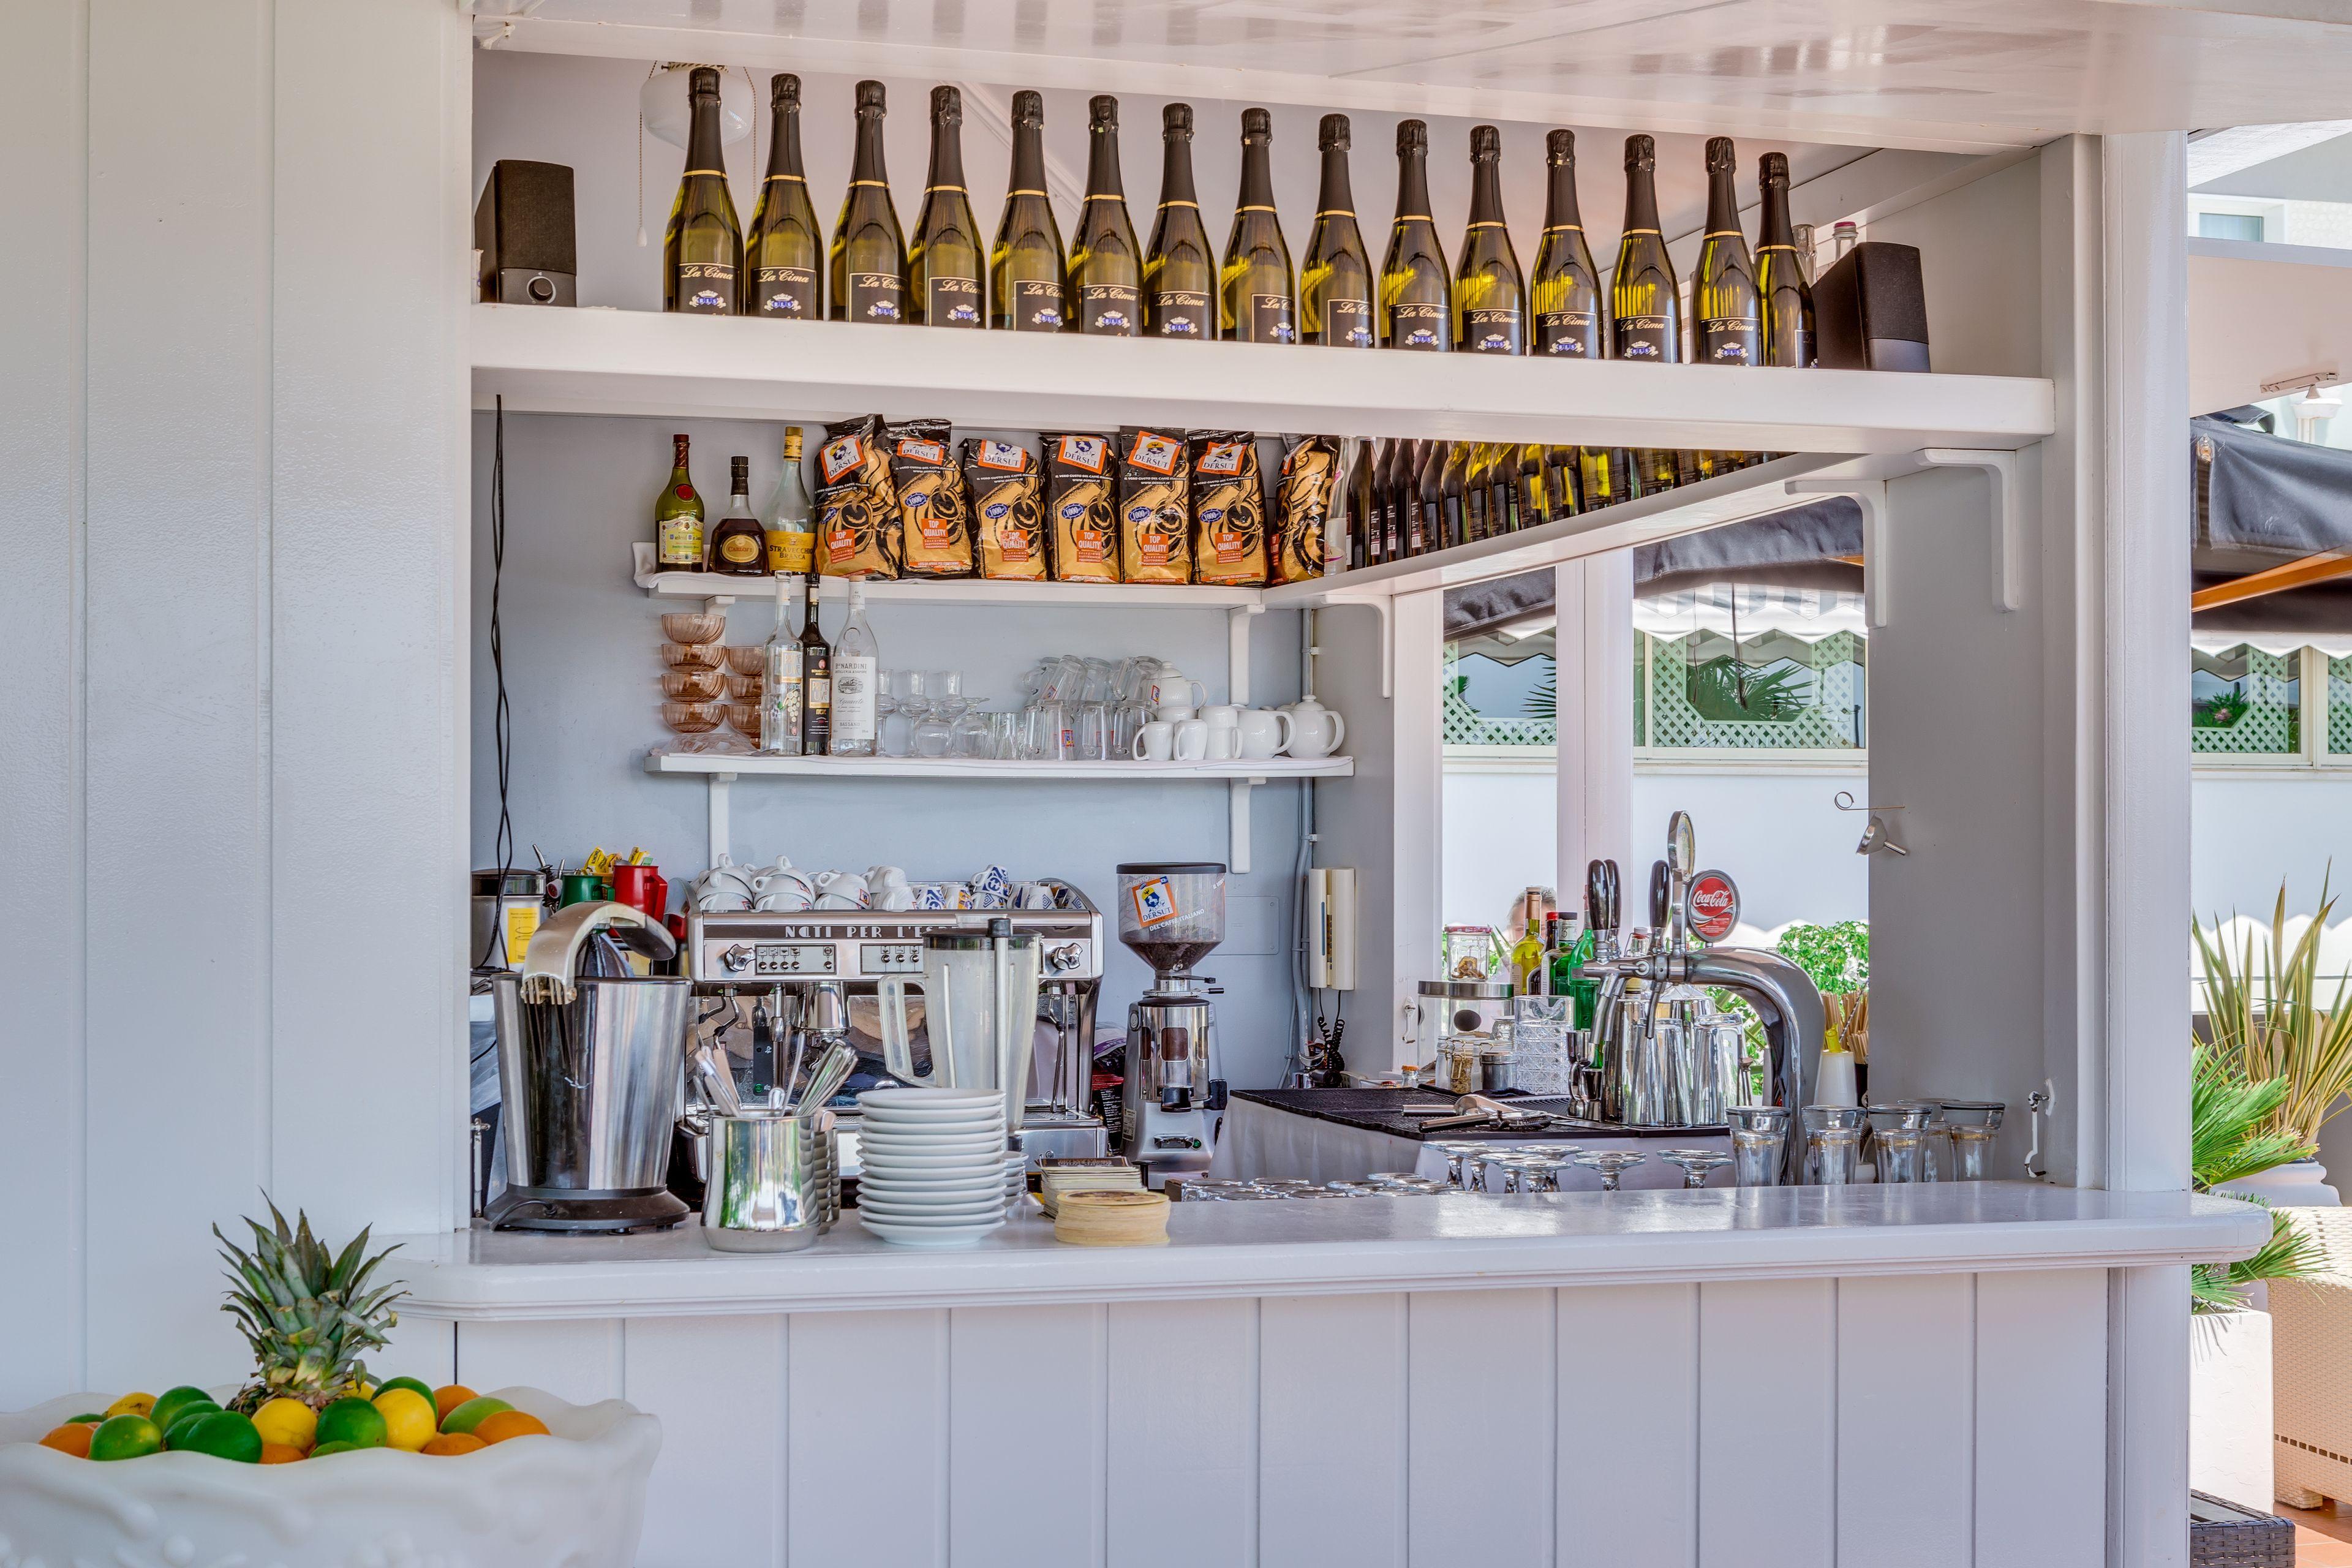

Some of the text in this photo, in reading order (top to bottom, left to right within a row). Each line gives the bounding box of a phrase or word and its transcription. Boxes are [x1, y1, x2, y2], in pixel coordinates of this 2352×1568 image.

[681, 266, 733, 280] La Cima
[757, 270, 810, 283] La Cima
[858, 276, 880, 287] La
[938, 280, 959, 292] La
[1023, 283, 1044, 295] La
[1087, 287, 1136, 301] La Cima
[1155, 293, 1205, 306] La Cima
[1261, 297, 1280, 309] La
[1336, 302, 1356, 314] La
[1396, 306, 1446, 319] La Cima
[1470, 311, 1518, 323] La Cima
[1542, 314, 1590, 327] La Cima
[1621, 318, 1665, 331] La Cima
[1706, 318, 1754, 333] La Cima
[903, 447, 937, 461] DERSUT
[1065, 451, 1098, 467] DERSUT
[829, 456, 858, 477] DERSUT
[985, 455, 1020, 467] DERSUT
[1134, 454, 1169, 469] DERSUT
[989, 507, 1003, 516] 1000
[1066, 506, 1079, 516] 1000
[1133, 510, 1145, 519] 1000
[924, 528, 946, 537] QUALITY
[1007, 531, 1020, 540] TOP
[769, 545, 813, 554] STRAVECCHIO
[831, 538, 853, 549] QUALITY
[1002, 539, 1027, 549] QUALITY
[1079, 540, 1101, 549] QUALITY
[1143, 543, 1167, 552] QUALITY
[1218, 541, 1241, 551] QUALITY
[1692, 890, 1730, 907] Coca-Cola
[1142, 907, 1172, 921] DERSUT
[1149, 923, 1161, 932] DEL
[1179, 908, 1205, 922] ITALIANO
[846, 926, 882, 938] PER
